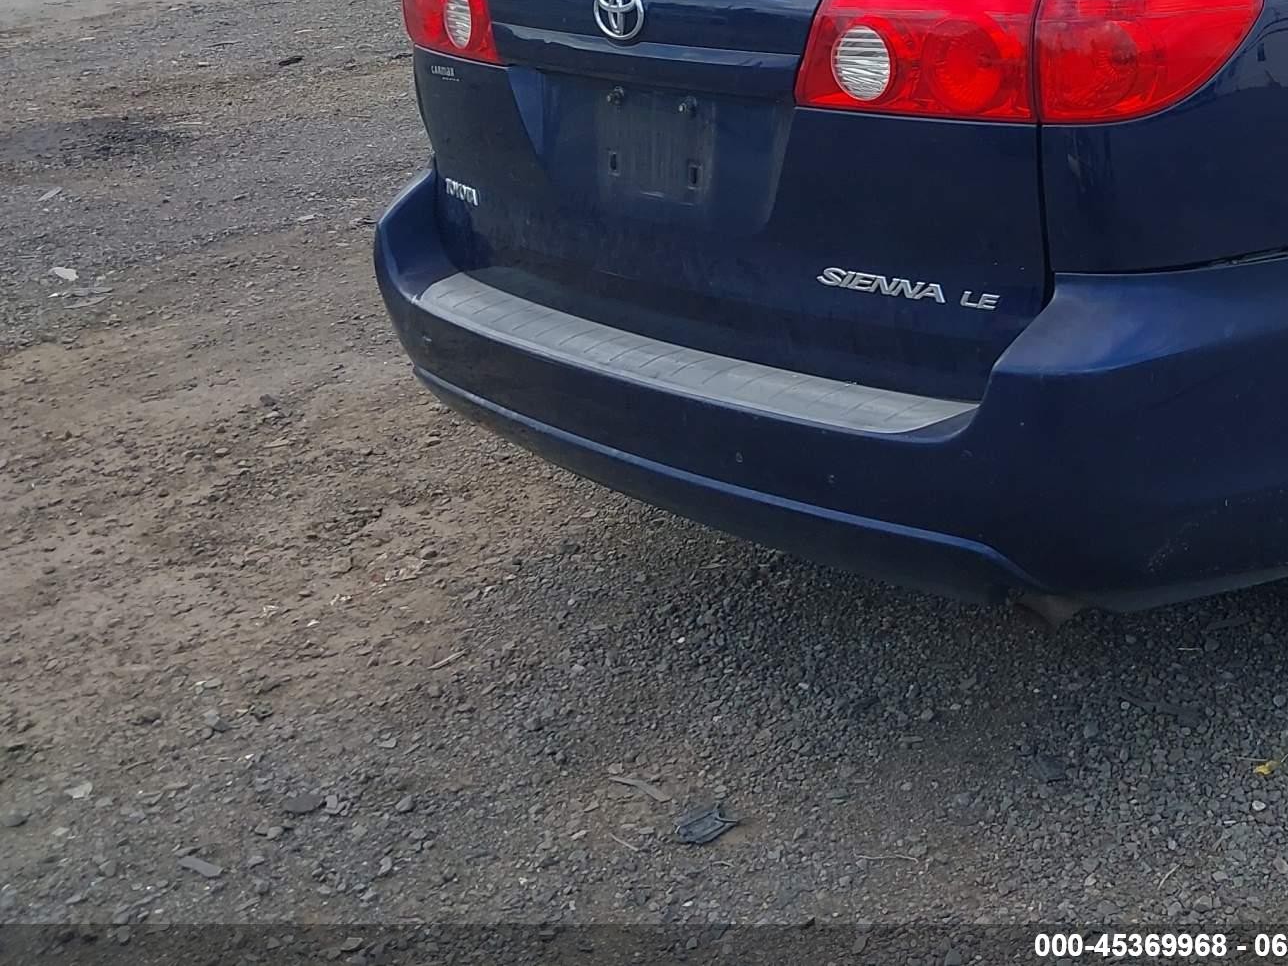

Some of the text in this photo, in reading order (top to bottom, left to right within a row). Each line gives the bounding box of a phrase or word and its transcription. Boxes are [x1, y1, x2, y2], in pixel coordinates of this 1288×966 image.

[446, 177, 478, 206] TOYOTA
[816, 266, 1001, 310] SIENNA LE
